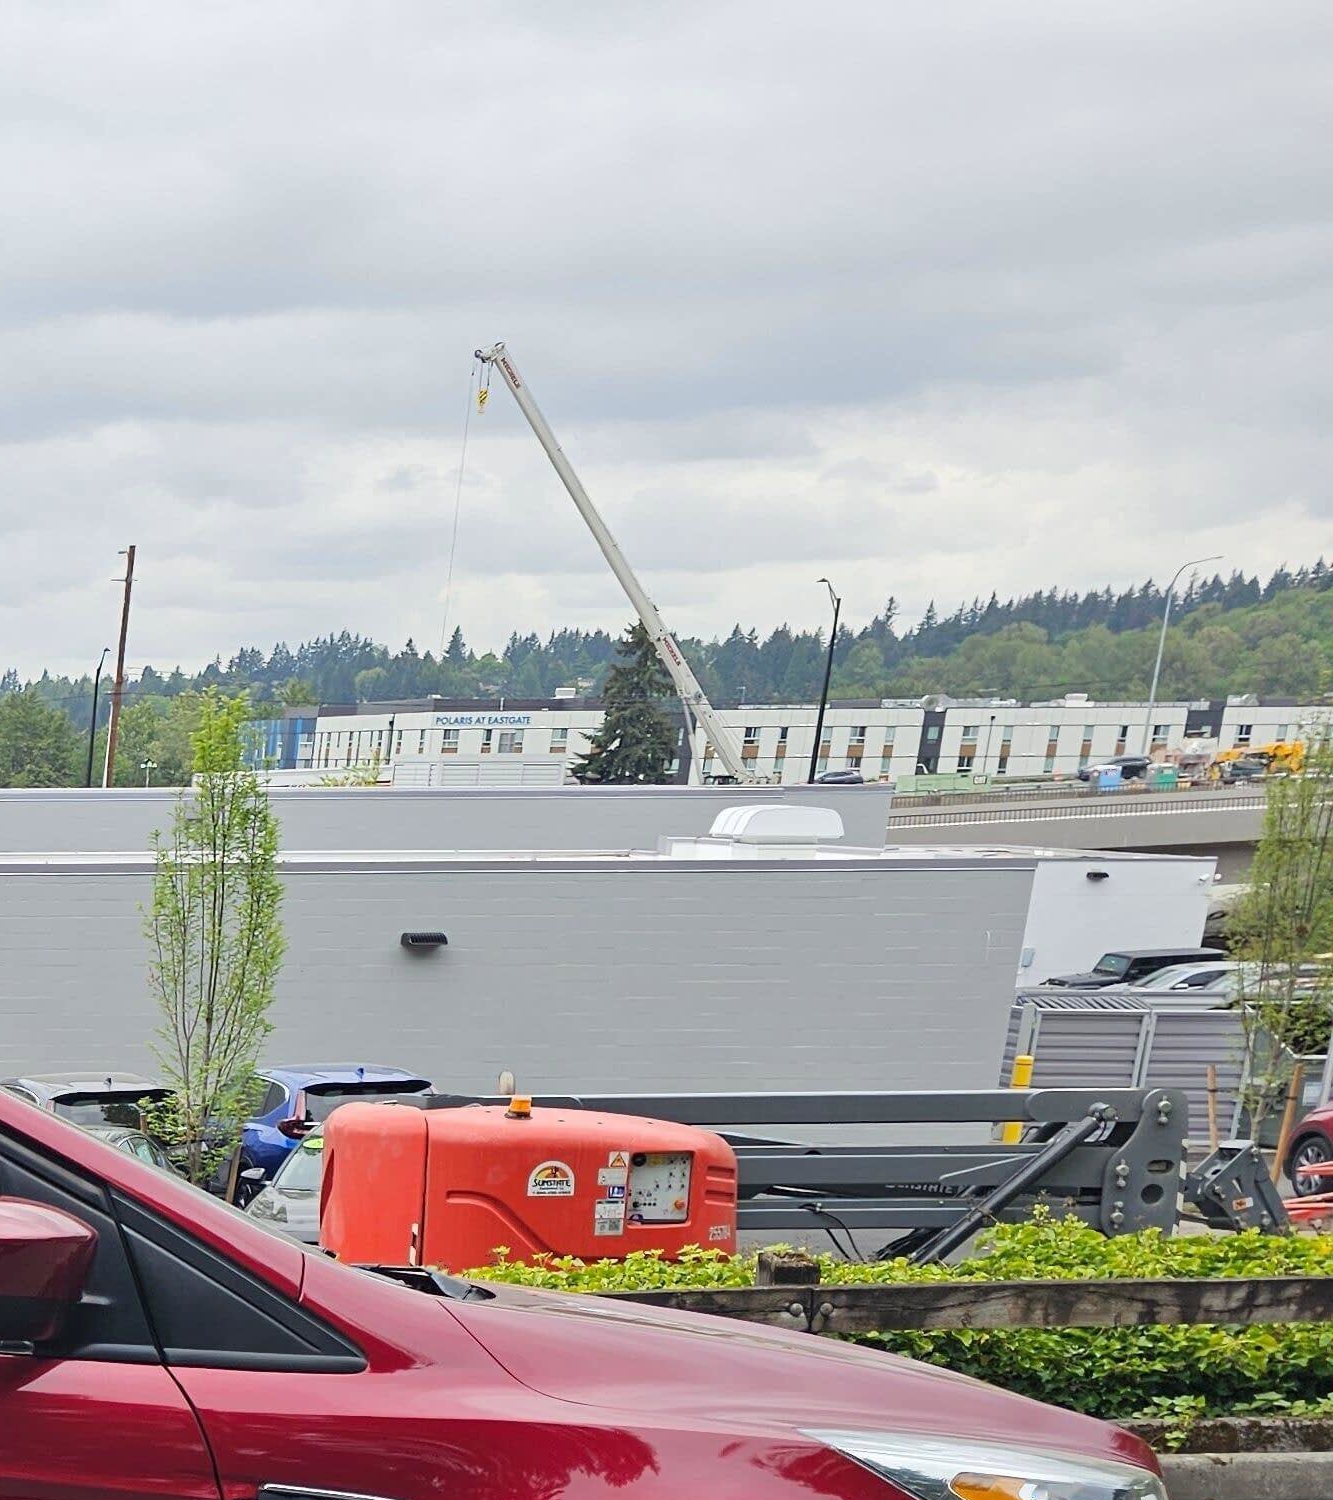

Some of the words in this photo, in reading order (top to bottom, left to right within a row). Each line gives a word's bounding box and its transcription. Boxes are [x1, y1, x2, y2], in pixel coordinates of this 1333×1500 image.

[435, 716, 473, 725] POLARIS
[474, 716, 486, 725] AT
[487, 716, 531, 725] EASTGATE
